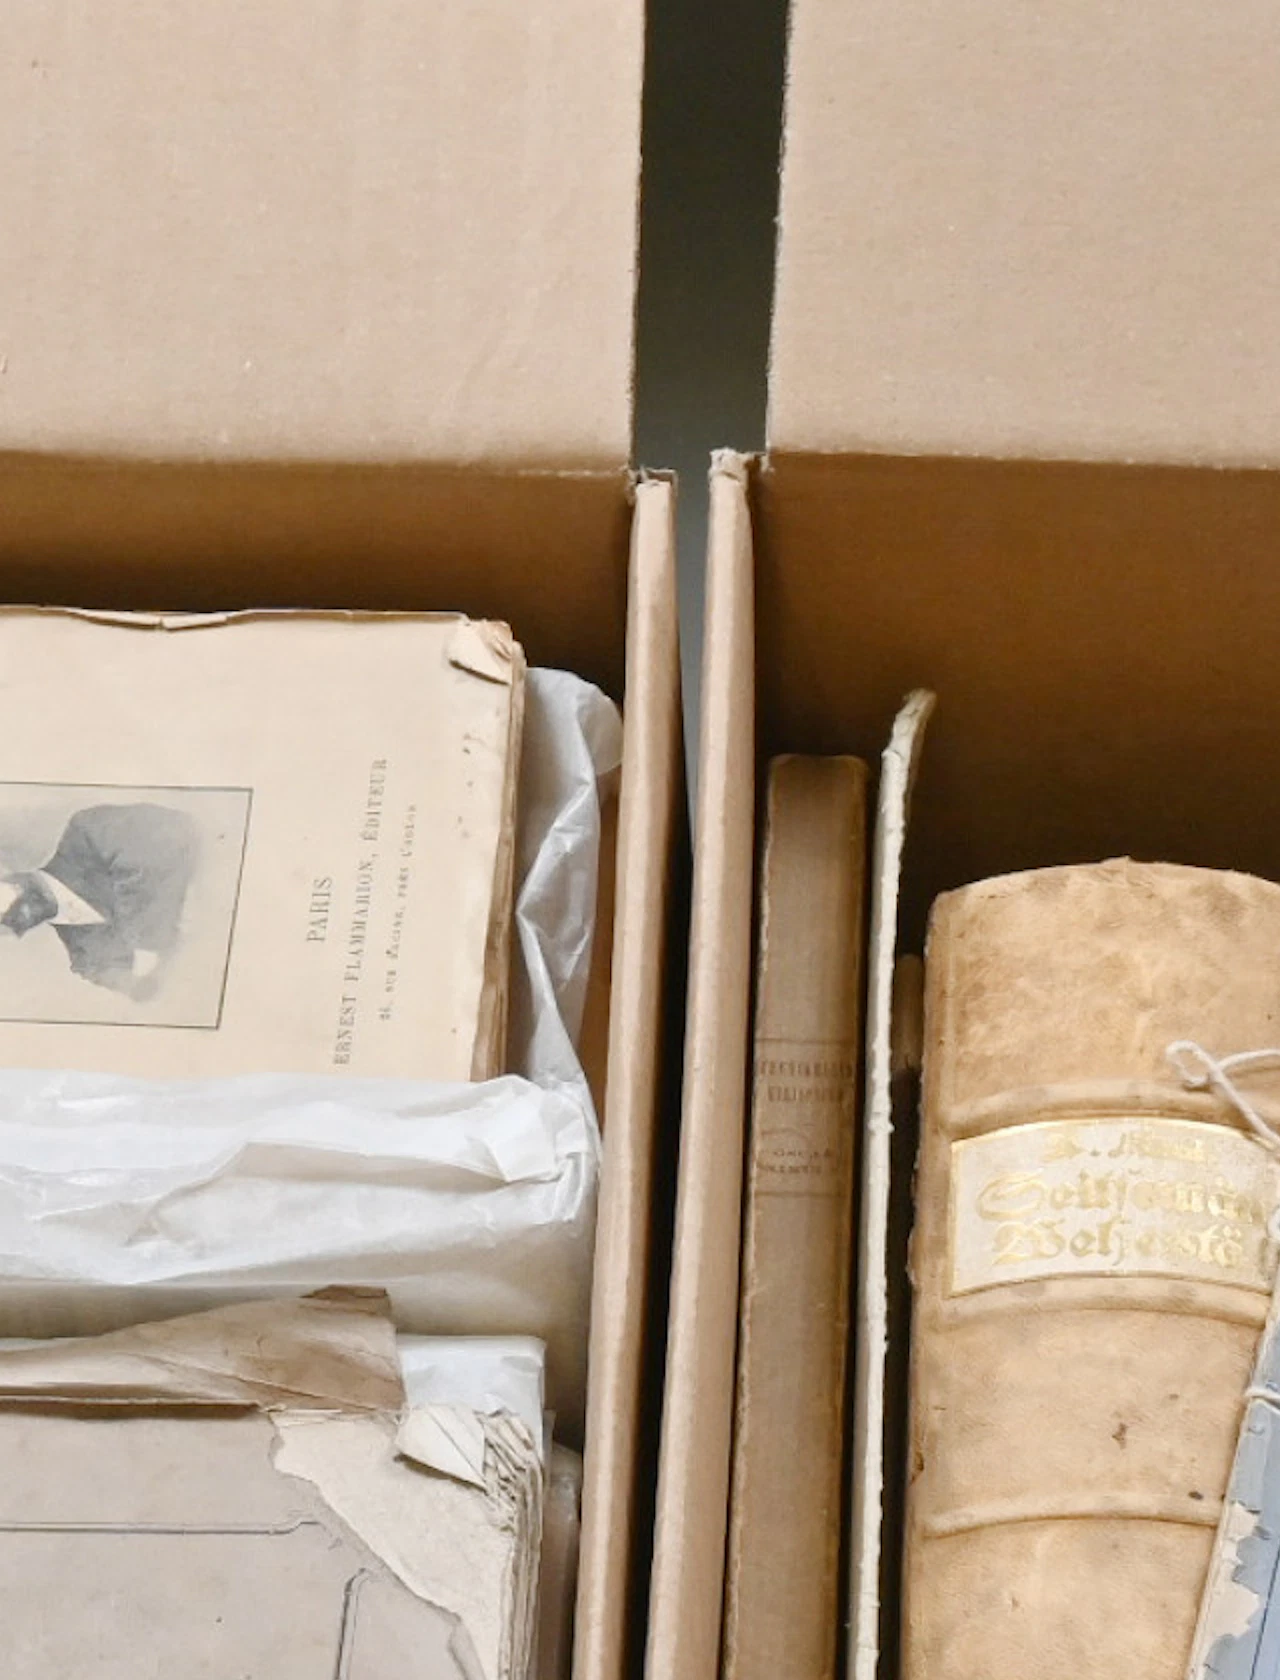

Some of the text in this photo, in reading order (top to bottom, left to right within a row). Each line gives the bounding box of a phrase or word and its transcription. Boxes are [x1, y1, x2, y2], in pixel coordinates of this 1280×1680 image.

[306, 876, 334, 943] PARIS
[333, 759, 388, 1066] ERNEST FLAMMARION, ÉDITEUR
